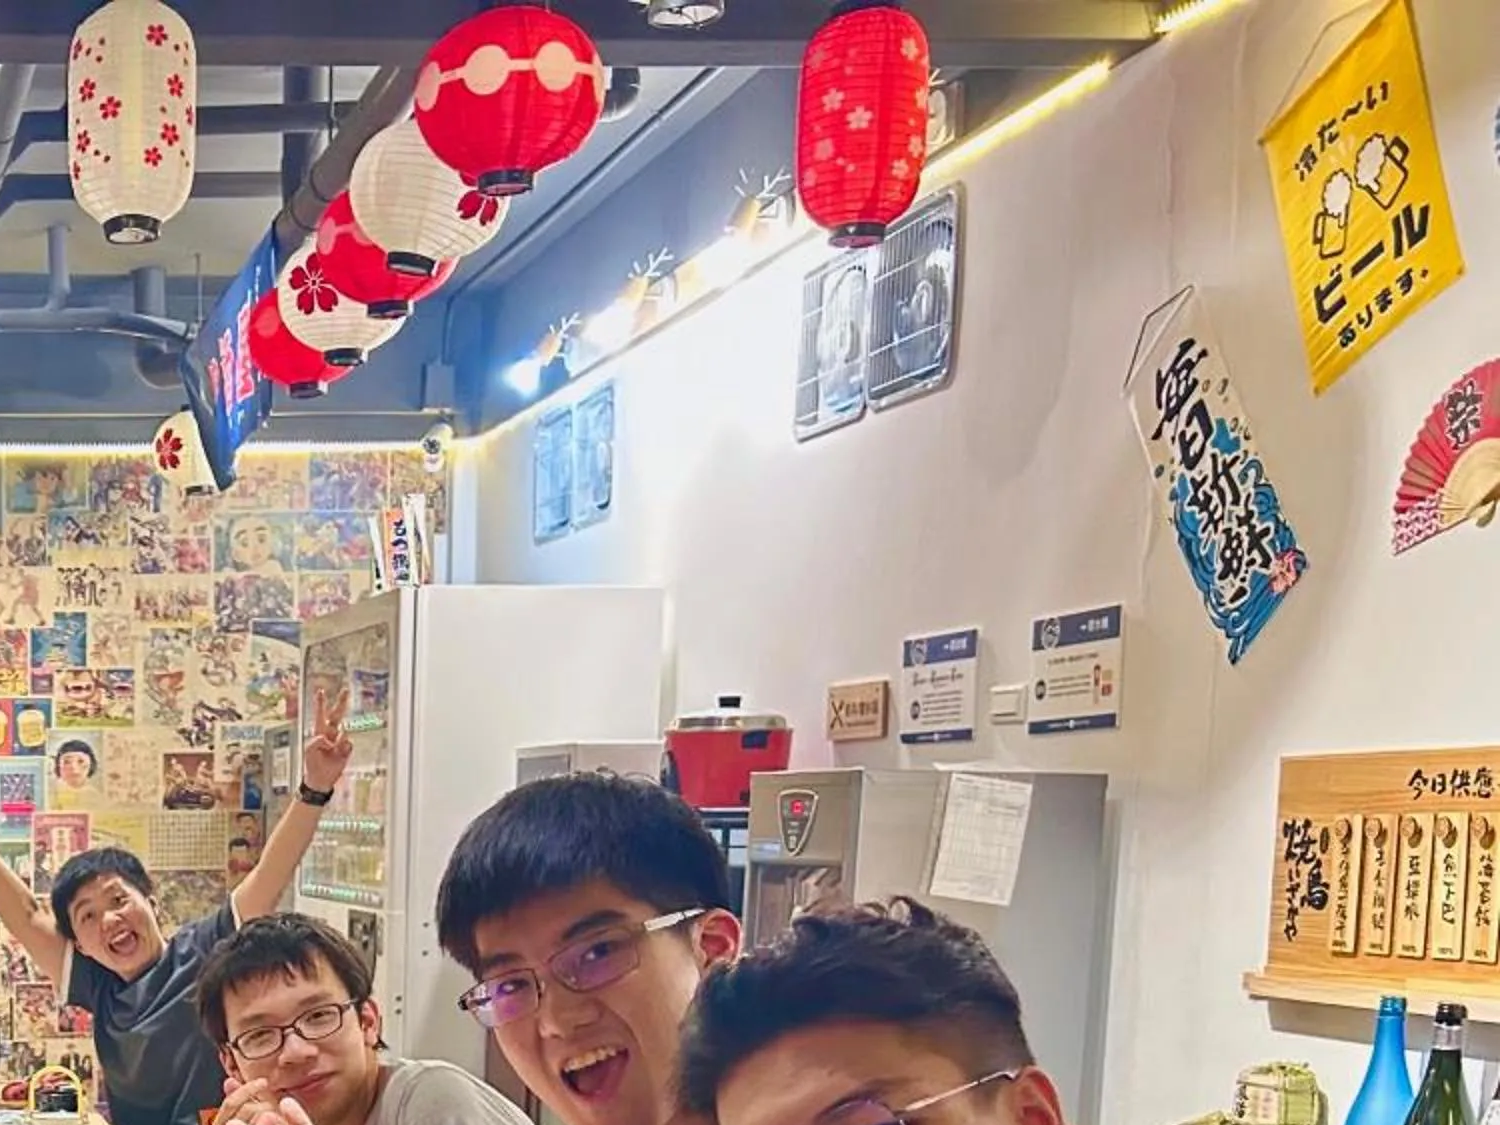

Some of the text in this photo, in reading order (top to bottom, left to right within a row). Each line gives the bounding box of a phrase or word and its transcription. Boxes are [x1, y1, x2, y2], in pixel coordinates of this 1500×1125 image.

[1313, 204, 1430, 324] ビール
[1408, 766, 1500, 800] 今日供應
